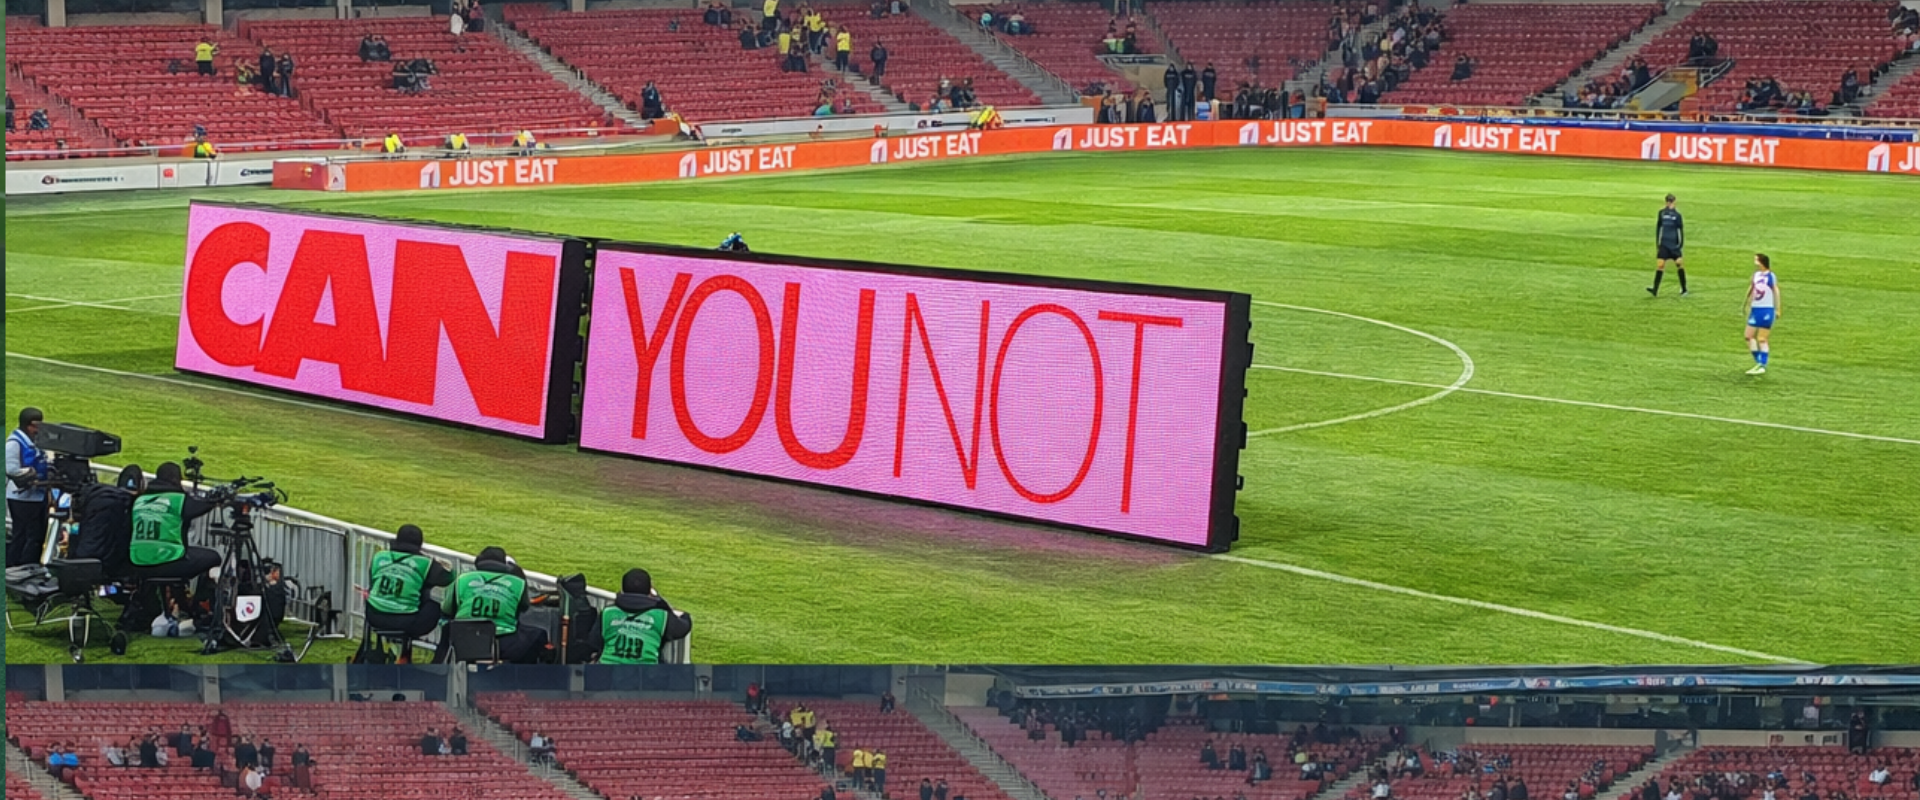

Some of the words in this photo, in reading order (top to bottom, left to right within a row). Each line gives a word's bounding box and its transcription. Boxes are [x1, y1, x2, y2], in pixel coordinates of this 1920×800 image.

[893, 135, 942, 160] JUST
[946, 132, 982, 156] EAT
[1079, 126, 1140, 148] JUST
[1147, 124, 1192, 146] EAT
[1266, 121, 1327, 144] JUST
[1332, 120, 1373, 143] EAT
[1457, 126, 1514, 150] JUST
[1519, 128, 1562, 152] EAT
[703, 149, 754, 174] JUST
[759, 146, 796, 170] EAT
[1668, 135, 1728, 162] JUST
[1734, 137, 1780, 165] EAT
[449, 160, 508, 186] JUST
[515, 158, 558, 183] EAT
[187, 221, 556, 426] CAN
[619, 267, 876, 470] YOU
[893, 292, 1183, 514] NOT
